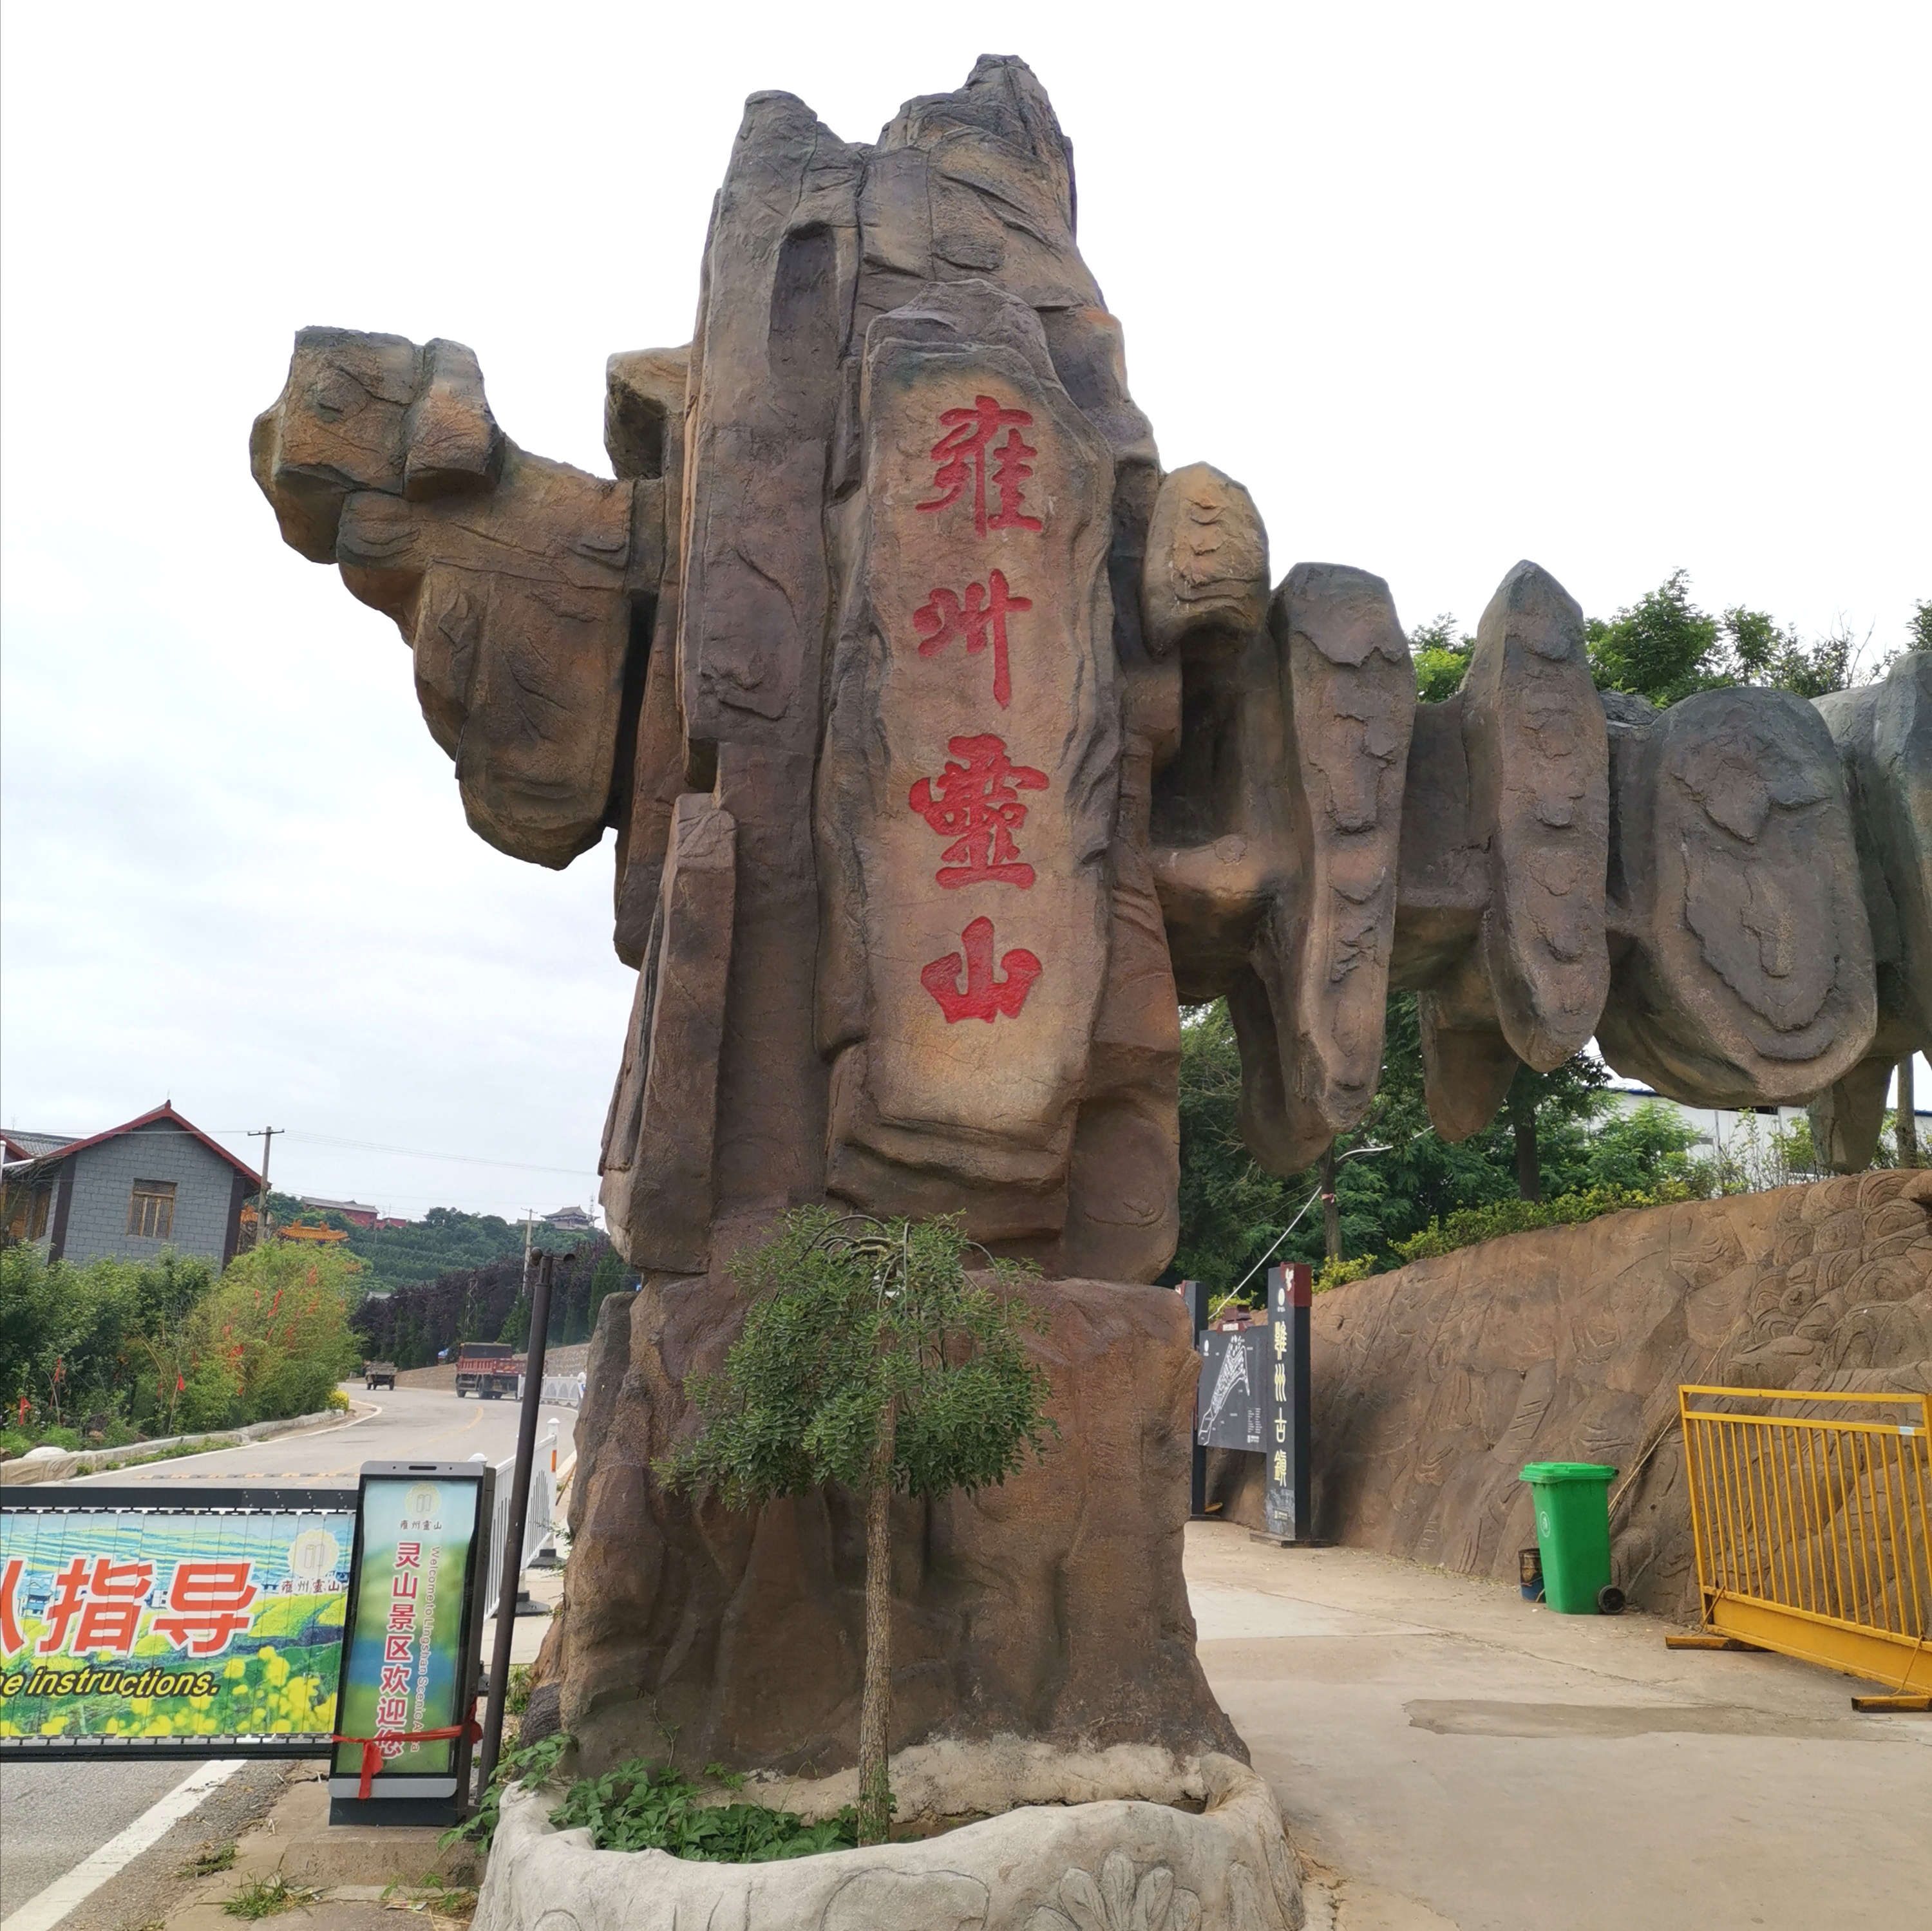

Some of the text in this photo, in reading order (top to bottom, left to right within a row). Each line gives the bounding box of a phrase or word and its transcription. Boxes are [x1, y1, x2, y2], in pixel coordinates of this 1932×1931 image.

[27, 1668, 218, 1696] instructions.
[376, 1542, 421, 1757] 灵山景区欢迎您
[410, 1546, 440, 1752] Welcome to Lingshan Scenic Aa
